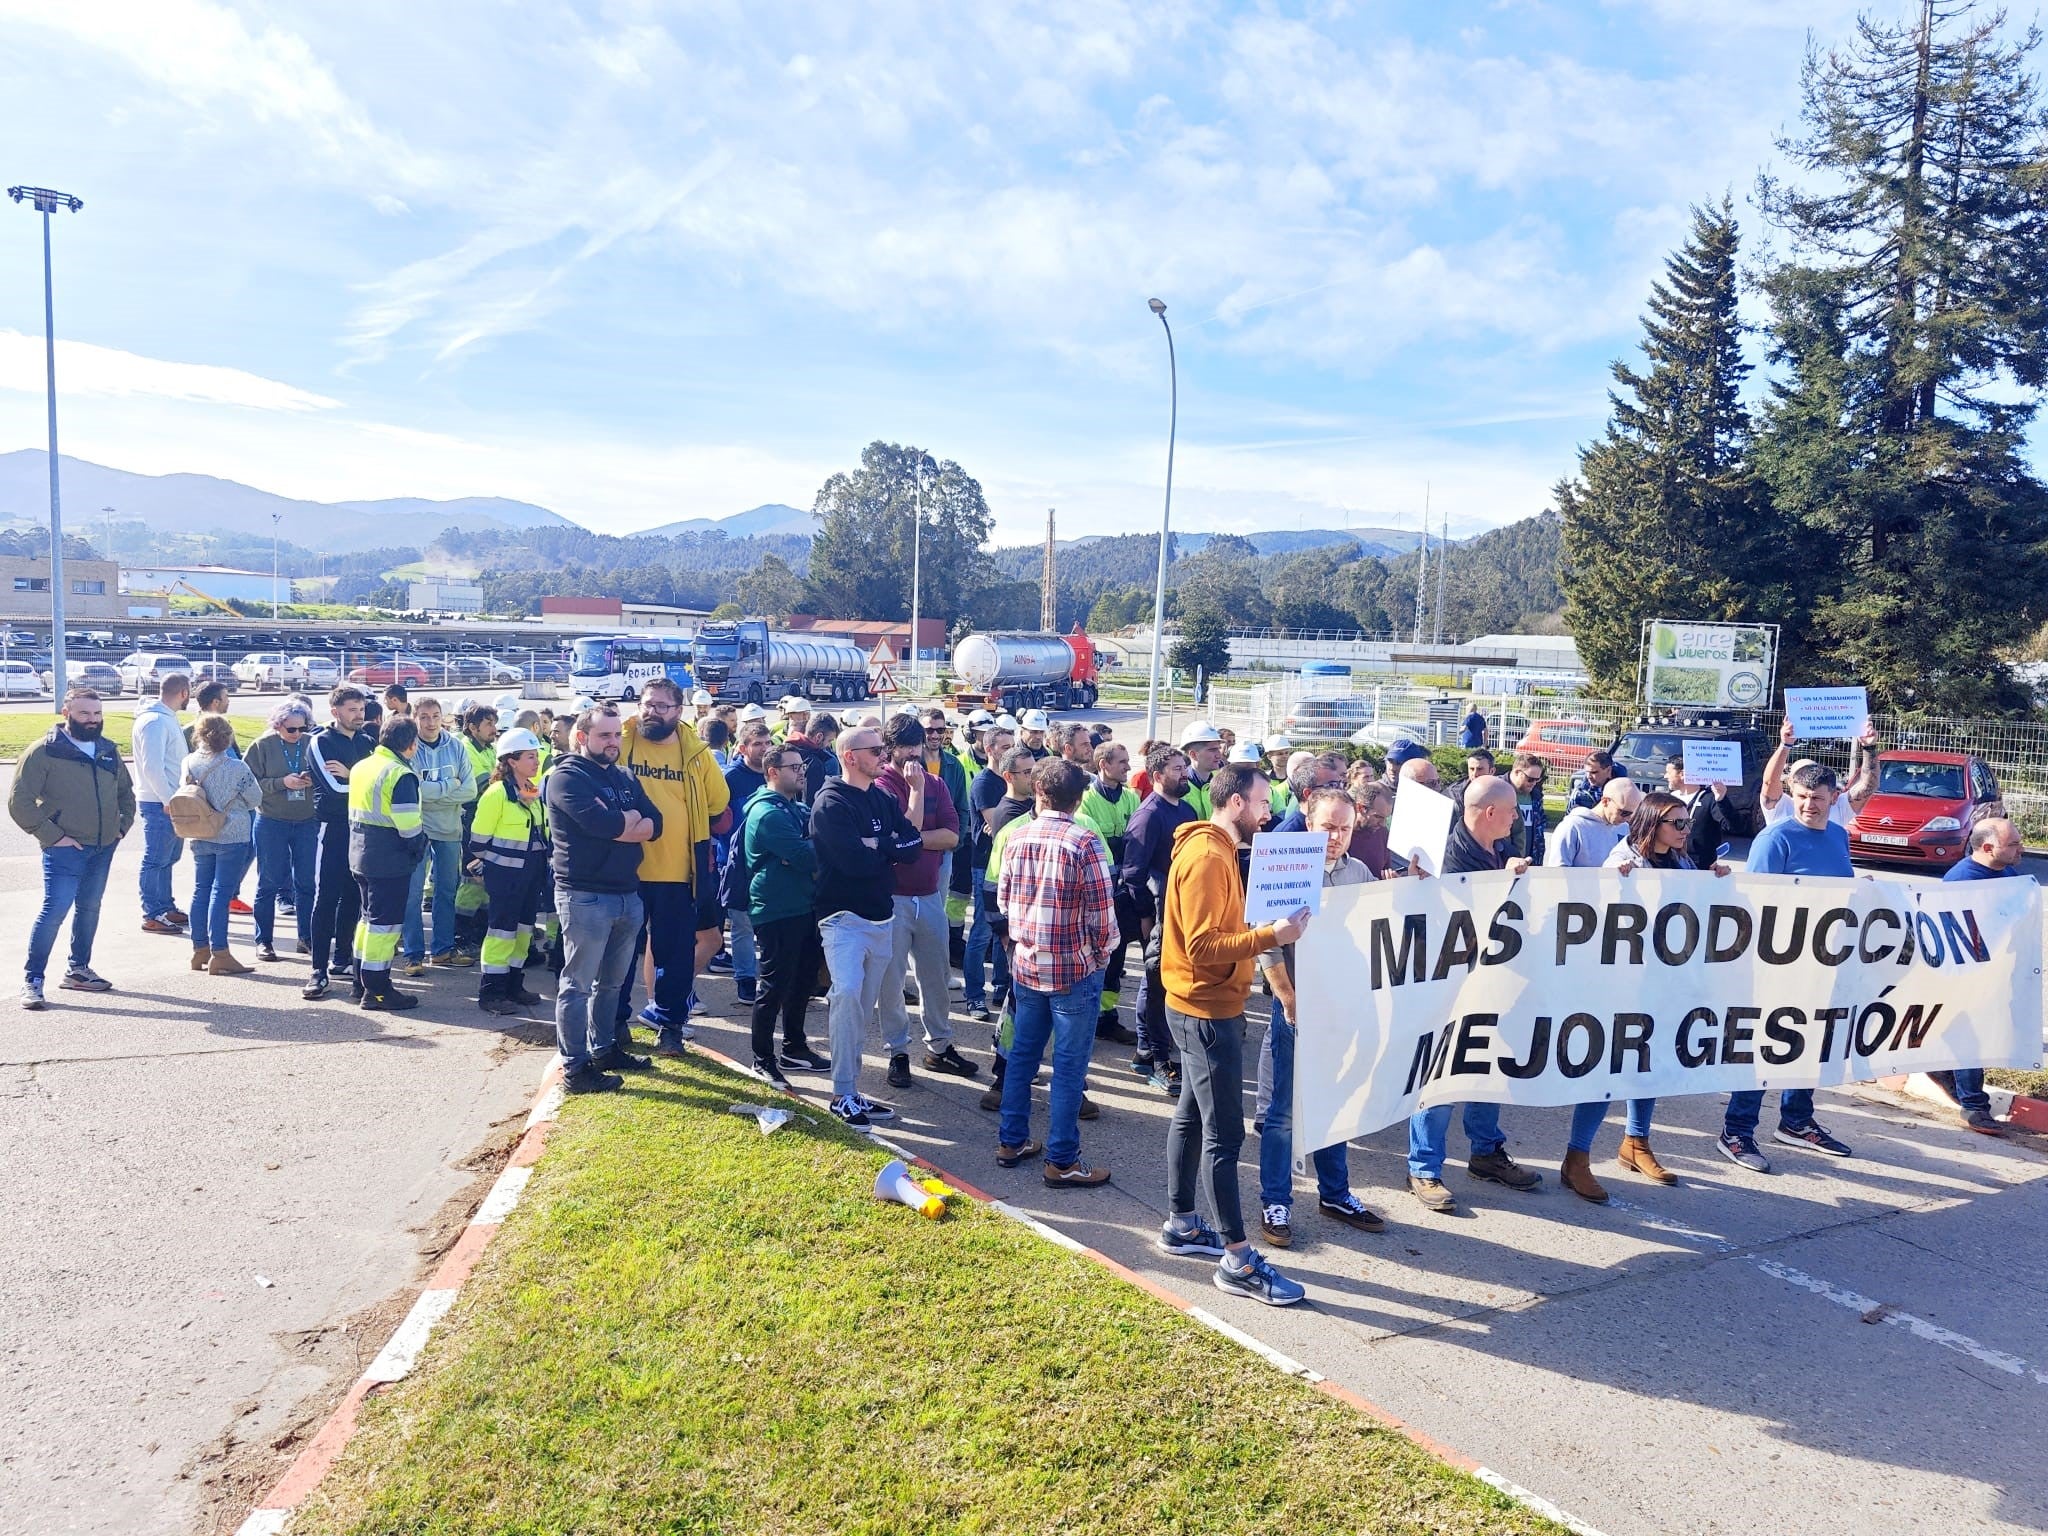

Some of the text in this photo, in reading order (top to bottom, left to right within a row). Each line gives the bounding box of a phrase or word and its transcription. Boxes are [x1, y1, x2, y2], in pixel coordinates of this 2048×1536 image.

[1682, 631, 1732, 648] ence
[1678, 646, 1729, 660] viveros
[628, 665, 661, 679] ROBLES
[1269, 847, 1277, 856] SIN
[1278, 847, 1288, 856] SUS
[1288, 846, 1323, 855] TRABAJADORES
[1289, 863, 1309, 872] FUTURO
[1260, 880, 1312, 891] POR UNA DIRECCIÓN
[1266, 898, 1302, 908] RESPONSABLE
[1555, 893, 1991, 968] PRODUCCIÓN
[1402, 985, 1944, 1097] MEJOR GESTIÓN
